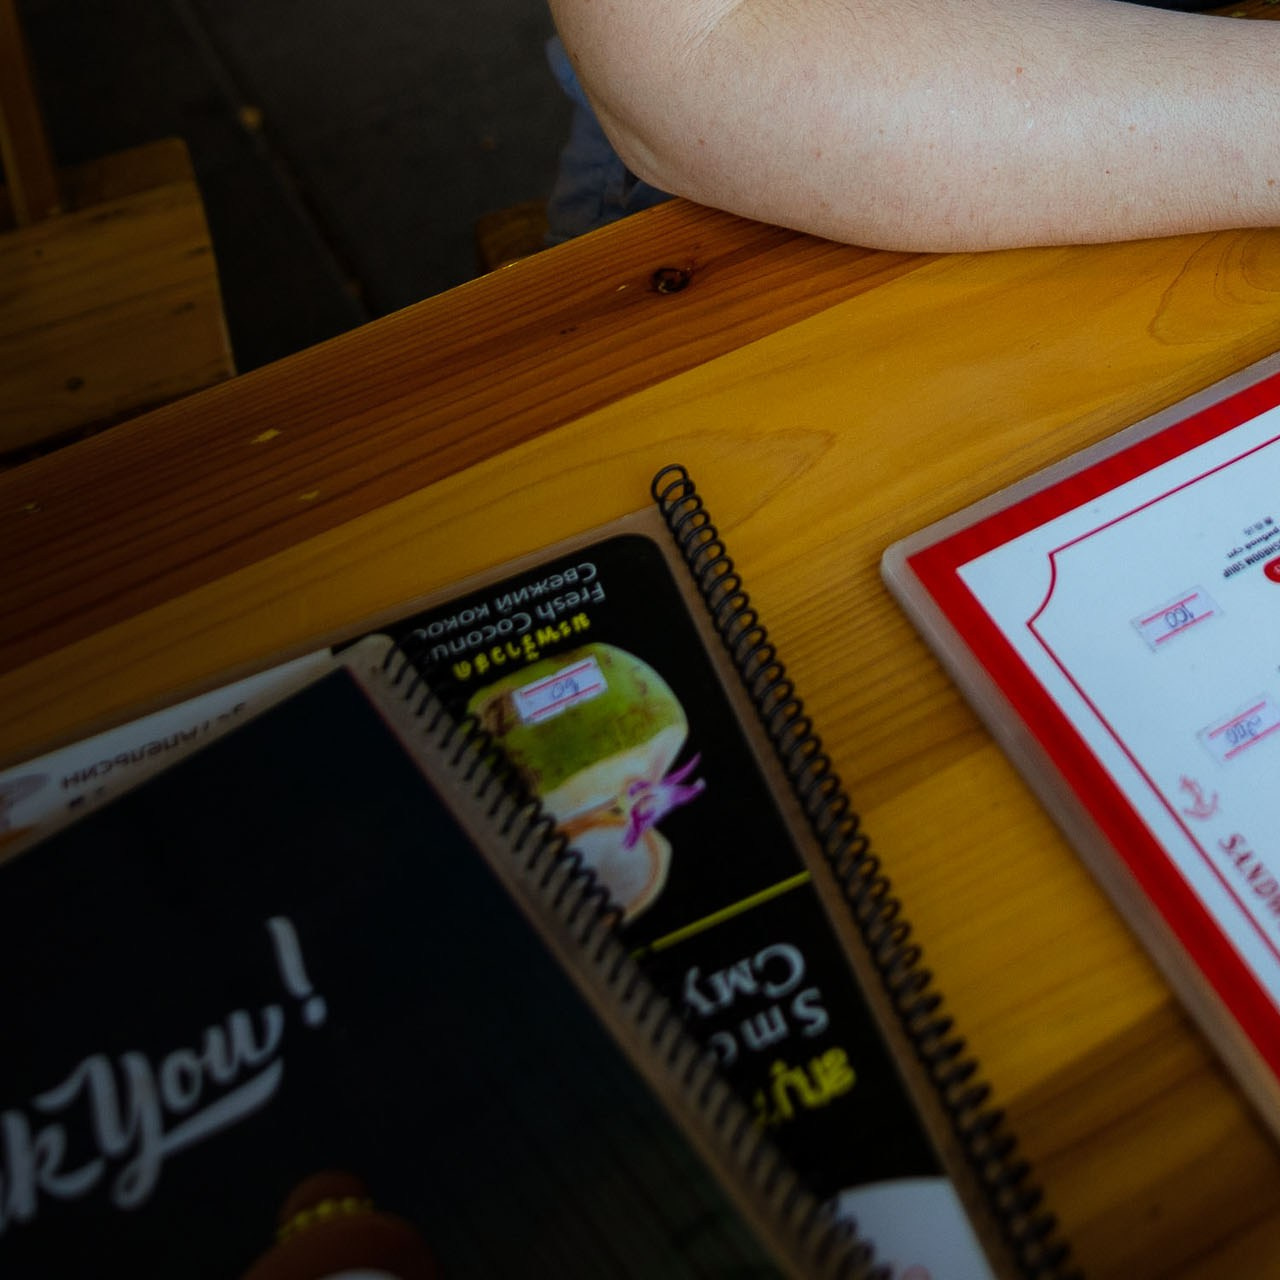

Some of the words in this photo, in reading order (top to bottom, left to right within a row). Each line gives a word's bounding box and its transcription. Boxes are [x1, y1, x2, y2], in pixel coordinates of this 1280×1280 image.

[492, 559, 598, 613] Свежий
[1221, 560, 1246, 577] SOUP
[532, 578, 606, 624] Fresh
[420, 608, 533, 668] Coconu
